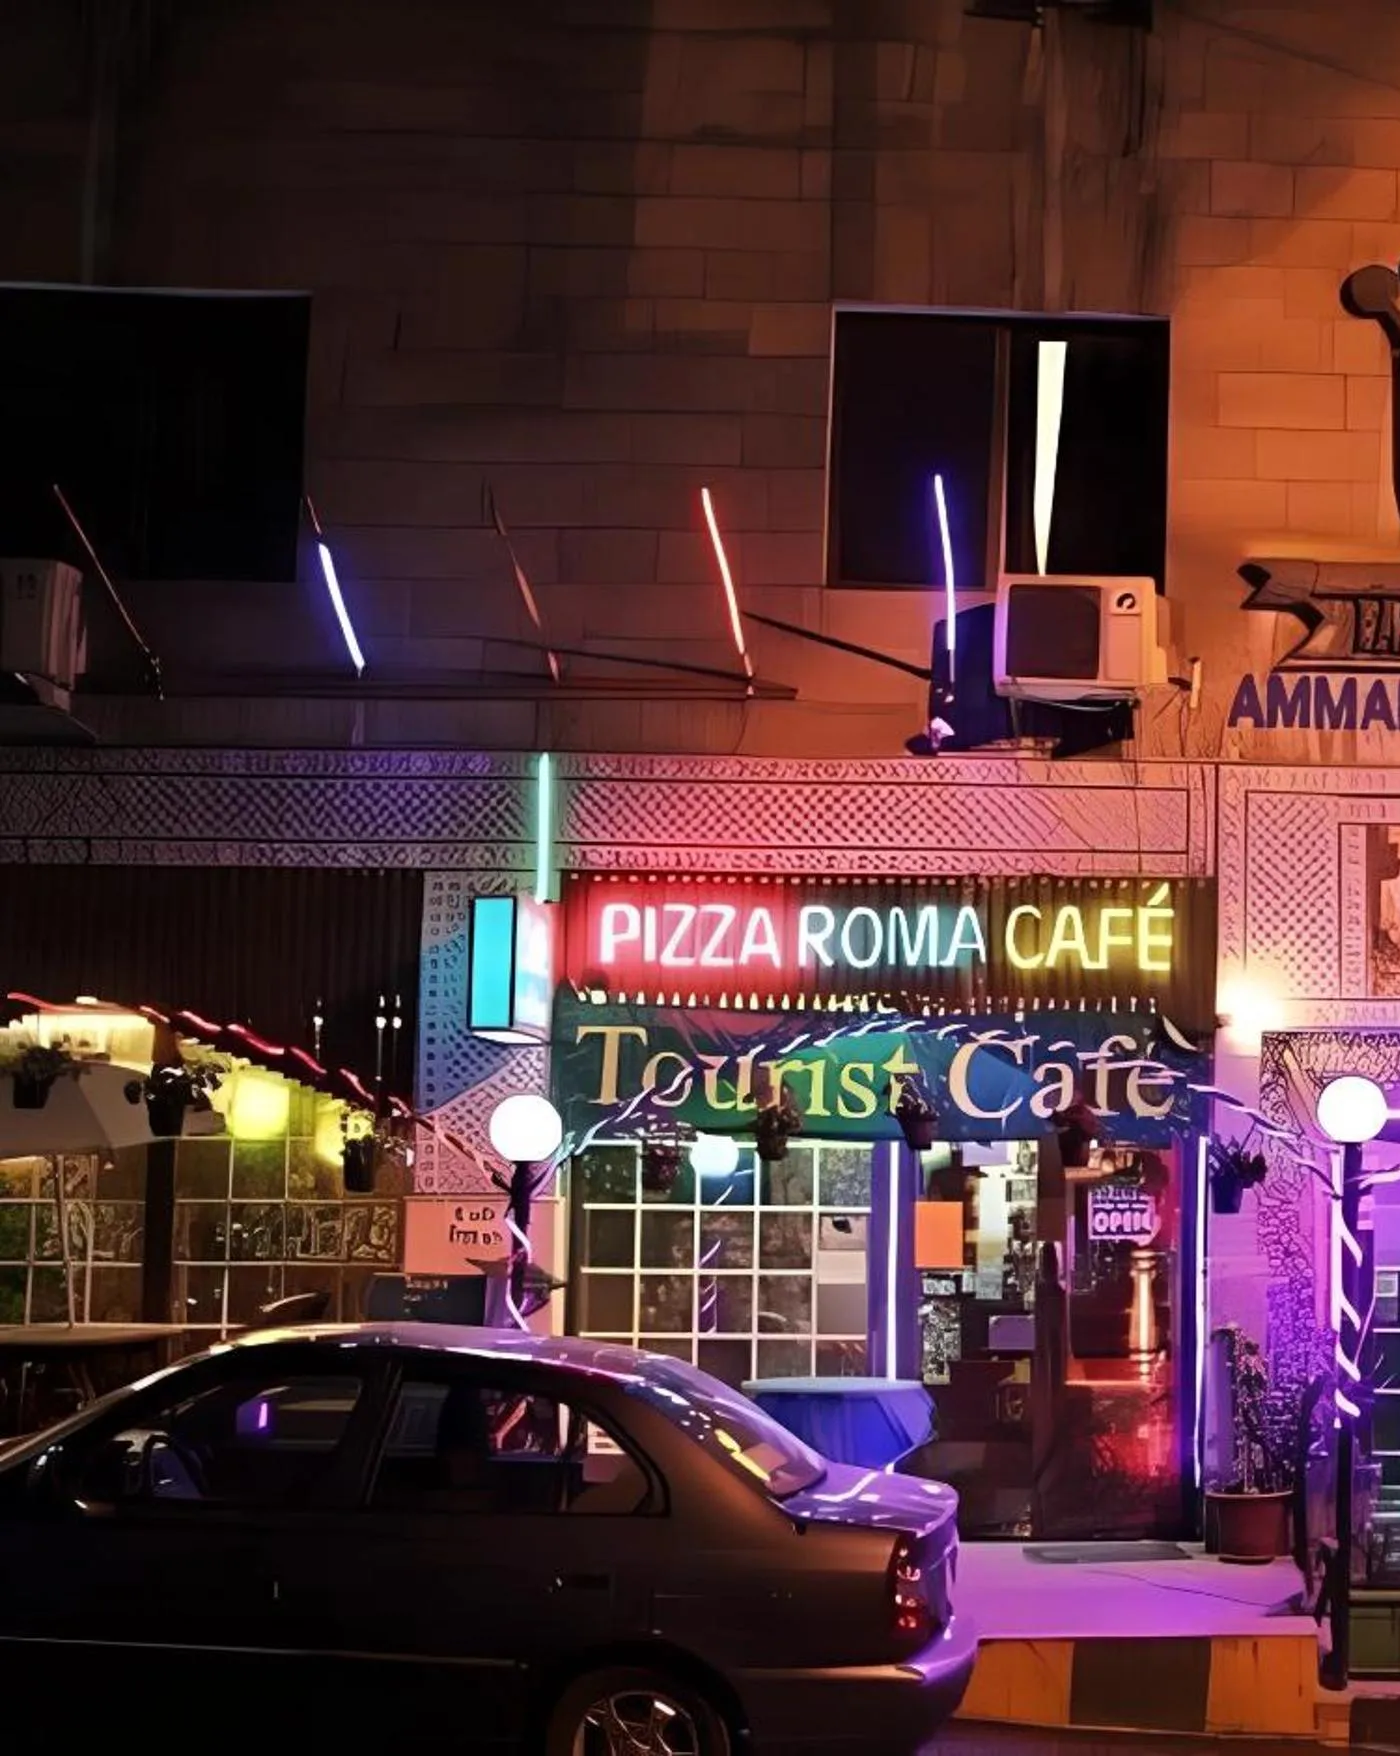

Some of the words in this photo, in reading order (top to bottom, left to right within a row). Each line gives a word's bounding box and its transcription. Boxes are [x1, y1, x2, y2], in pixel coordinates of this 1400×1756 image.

[598, 902, 782, 970] PIZZA
[797, 904, 987, 969] ROMA
[1004, 882, 1175, 973] CAFÉ
[575, 1022, 922, 1116] Tourist
